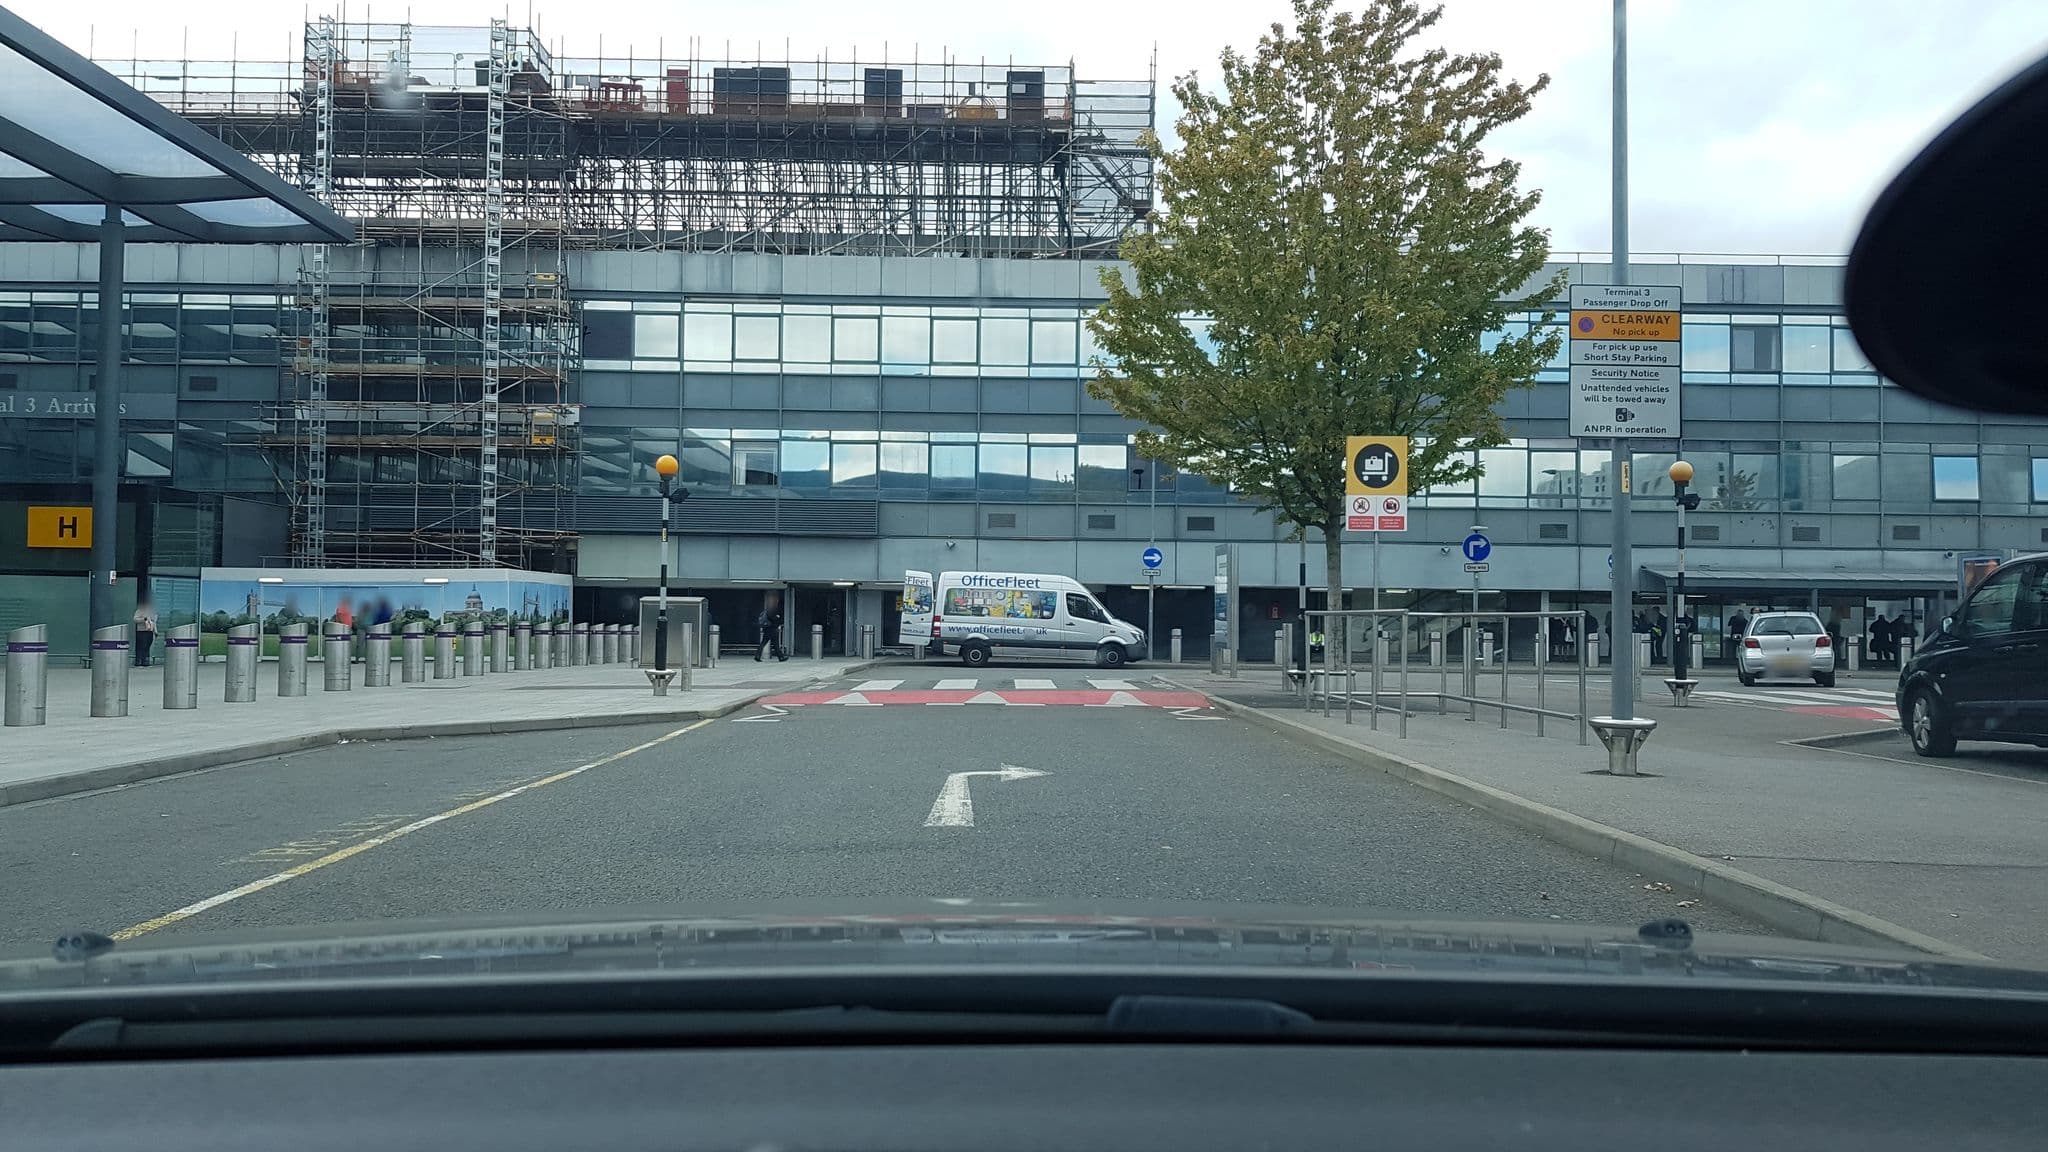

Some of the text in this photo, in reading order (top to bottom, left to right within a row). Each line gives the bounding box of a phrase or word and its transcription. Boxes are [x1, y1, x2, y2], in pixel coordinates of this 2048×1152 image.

[1584, 299, 1627, 307] Passenger
[1602, 315, 1670, 324] CLEARWAY
[1592, 369, 1628, 378] Security
[25, 398, 36, 412] 3
[47, 398, 126, 414] Arrivs
[59, 517, 77, 538] H
[962, 575, 1040, 589] OfficeFleet
[948, 625, 1048, 635] www.officefleet.cuk
